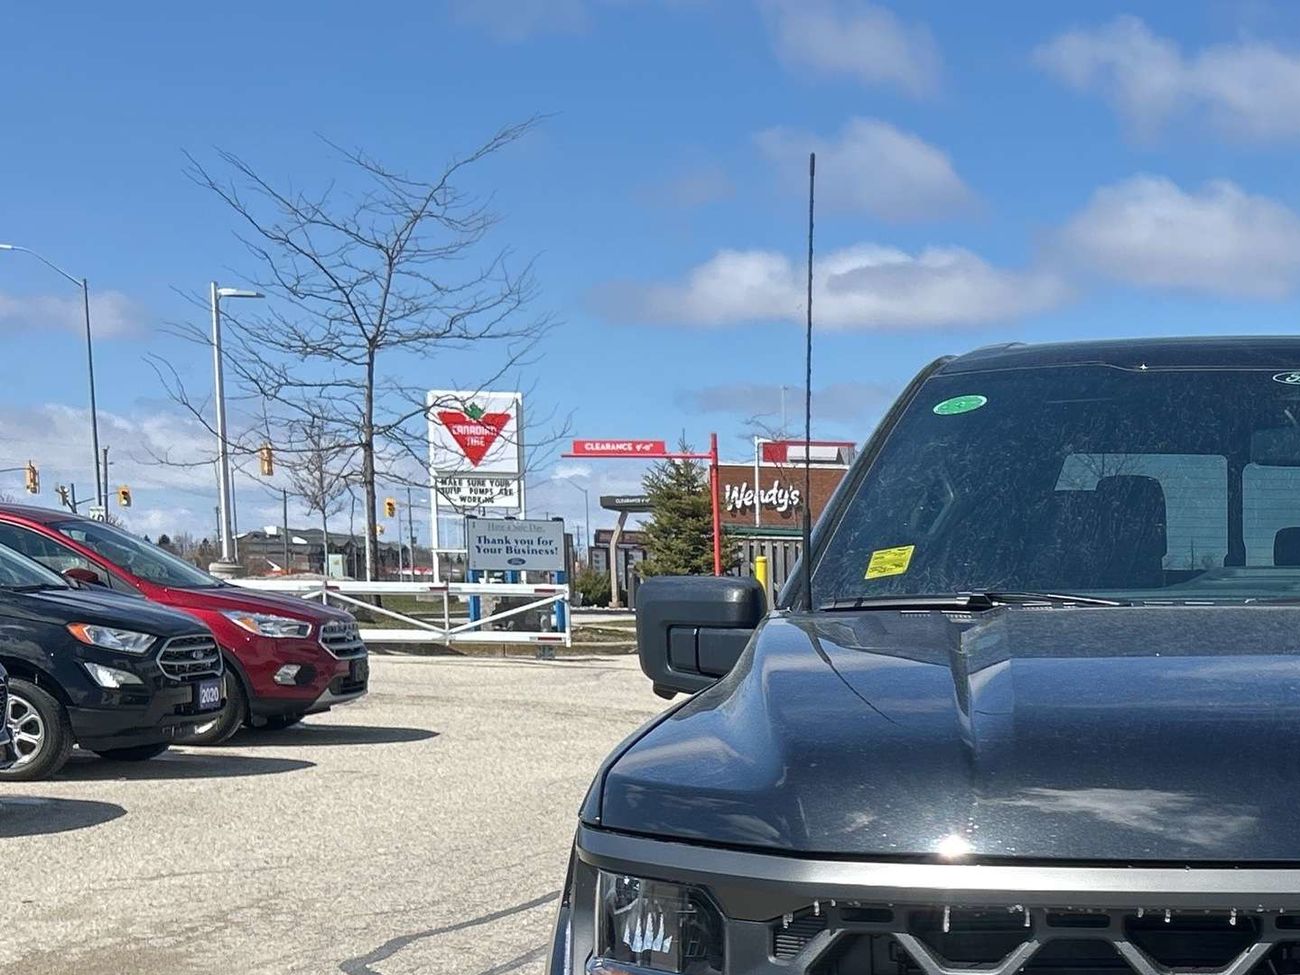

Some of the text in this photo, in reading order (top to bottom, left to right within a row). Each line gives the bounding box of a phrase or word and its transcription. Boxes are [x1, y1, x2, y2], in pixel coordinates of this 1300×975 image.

[465, 436, 485, 446] TIRE
[584, 442, 633, 451] CLEARANCE
[441, 478, 463, 487] MAKE
[467, 479, 486, 488] SURE
[469, 487, 494, 495] PUMPS
[725, 480, 800, 512] Wendy's
[459, 495, 495, 504] WORKING
[476, 535, 553, 547] Thank you for
[475, 545, 559, 555] Your Business!
[201, 687, 219, 703] 2020
